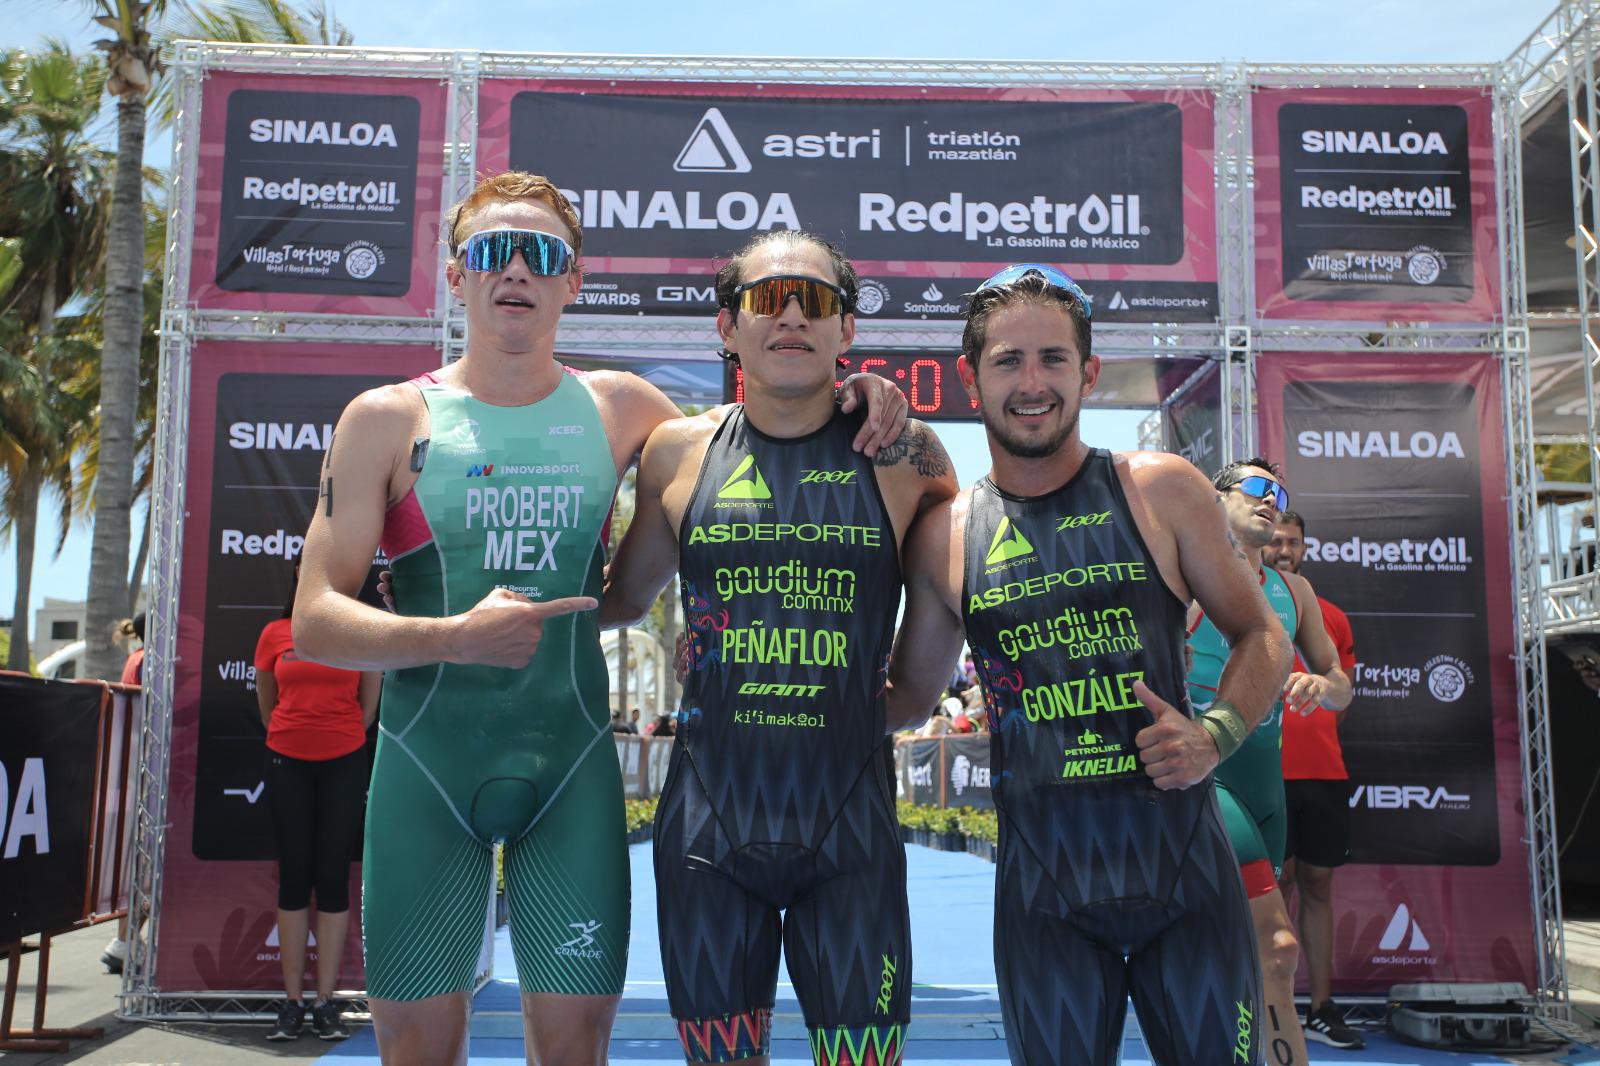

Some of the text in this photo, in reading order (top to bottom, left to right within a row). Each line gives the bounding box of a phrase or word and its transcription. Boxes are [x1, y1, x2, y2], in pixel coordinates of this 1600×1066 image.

[250, 118, 398, 147] SINALOA
[762, 128, 881, 159] astri
[927, 130, 1021, 146] triatlón
[1301, 130, 1448, 155] SINALOA
[928, 148, 1017, 161] mazatlán
[986, 236, 1140, 250] La Gasolina de México
[904, 302, 961, 314] Santander
[1297, 430, 1466, 459] SINALOA
[466, 485, 585, 529] PROBERT
[687, 523, 881, 547] ASDEPORTE
[483, 530, 562, 571] MEX
[1375, 562, 1385, 571] La
[1386, 562, 1423, 572] Gasolina
[1424, 563, 1436, 572] de
[715, 559, 857, 602] gaudium
[968, 562, 1148, 615] ASDEPORTE
[781, 593, 854, 614] .com.mx
[721, 619, 848, 668] PEÑAFLOR
[998, 606, 1138, 662] gaudium
[738, 682, 827, 697] GIANT
[1064, 743, 1122, 757] PETROLIKE
[1062, 754, 1137, 778] IKNELIA
[1348, 784, 1470, 809] VIBRA
[554, 946, 603, 959] CONADE
[1371, 955, 1438, 966] asdeporte
